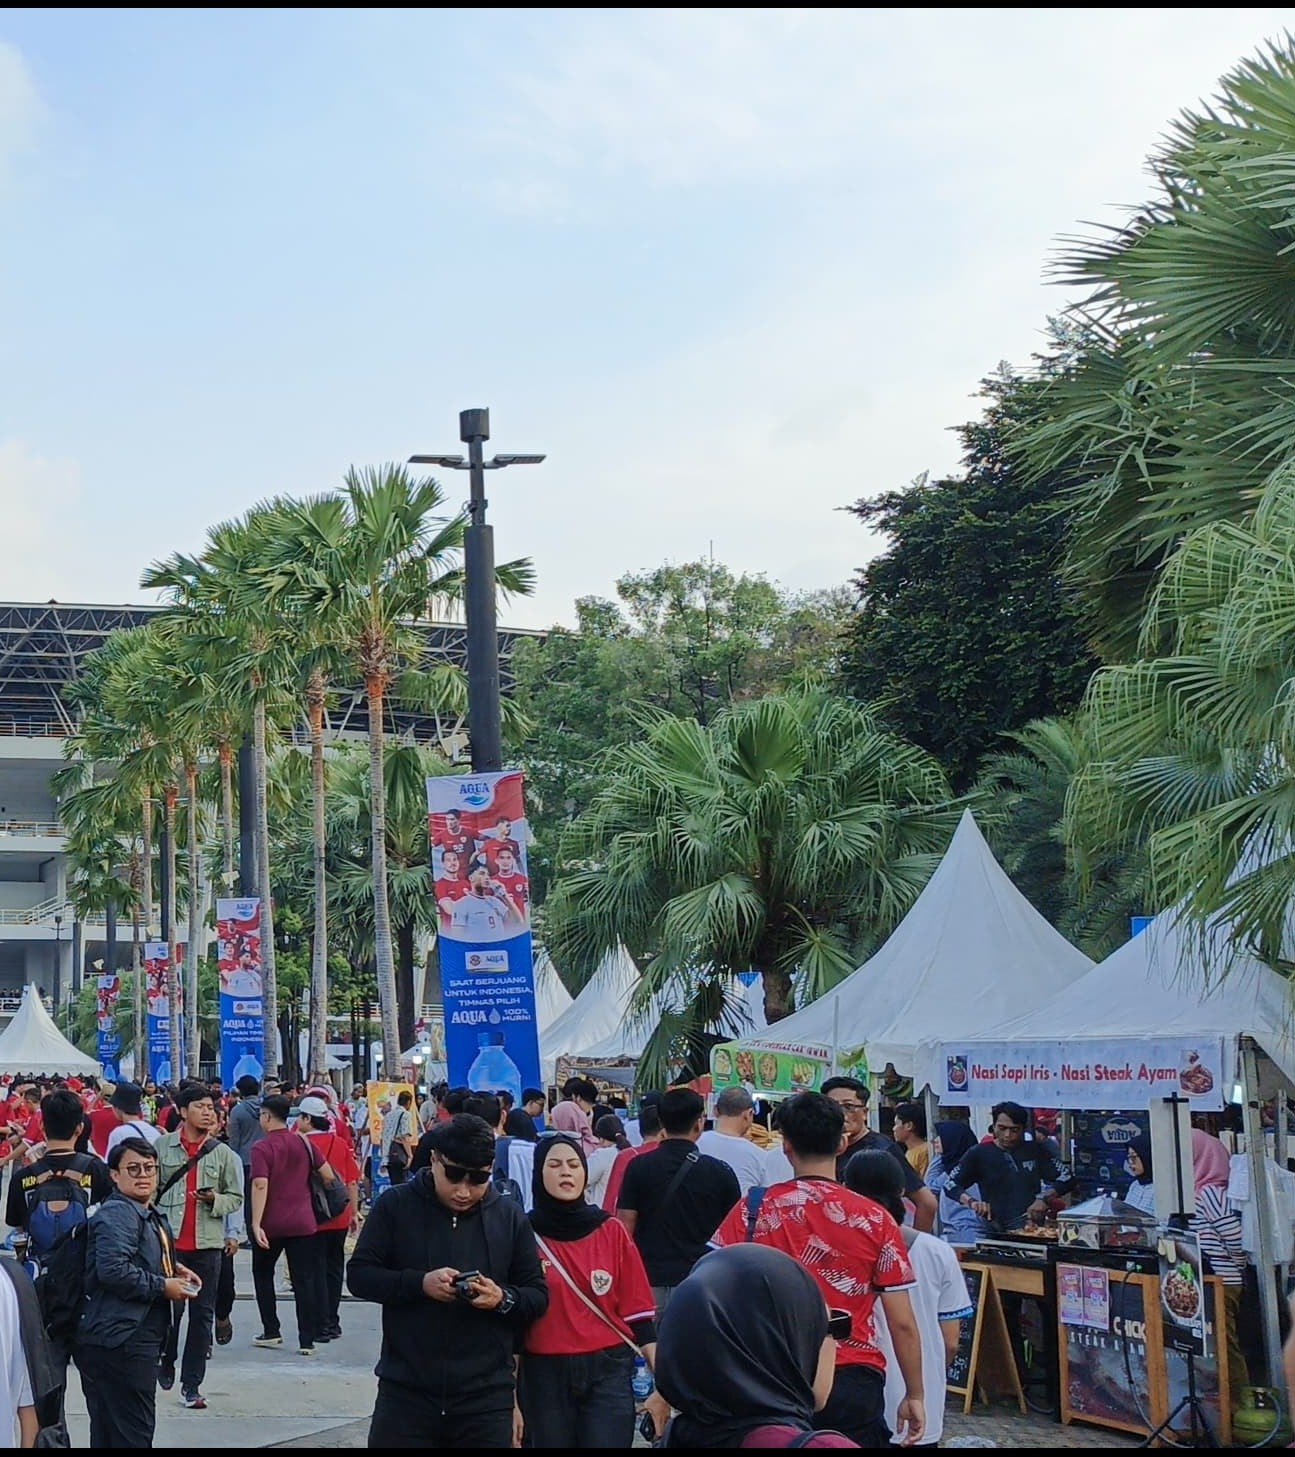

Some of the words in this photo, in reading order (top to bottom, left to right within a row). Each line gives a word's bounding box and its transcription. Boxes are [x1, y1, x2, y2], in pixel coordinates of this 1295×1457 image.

[459, 782, 490, 795] AQUA
[449, 979, 474, 987] SAAT
[475, 976, 527, 985] BERJUANG
[444, 989, 478, 997] UNTUK
[478, 986, 533, 996] INDONESIA,
[458, 998, 495, 1007] TIMNAS
[496, 997, 521, 1005] PILIH
[451, 1010, 488, 1025] AQUA
[223, 1019, 246, 1030] AQUA
[971, 1063, 999, 1080] Nasi
[1001, 1063, 1027, 1084] Sapi
[1030, 1063, 1050, 1080] Iris
[1061, 1064, 1090, 1082] Nasi
[1094, 1063, 1133, 1082] Steak
[1137, 1063, 1177, 1085] Ayam
